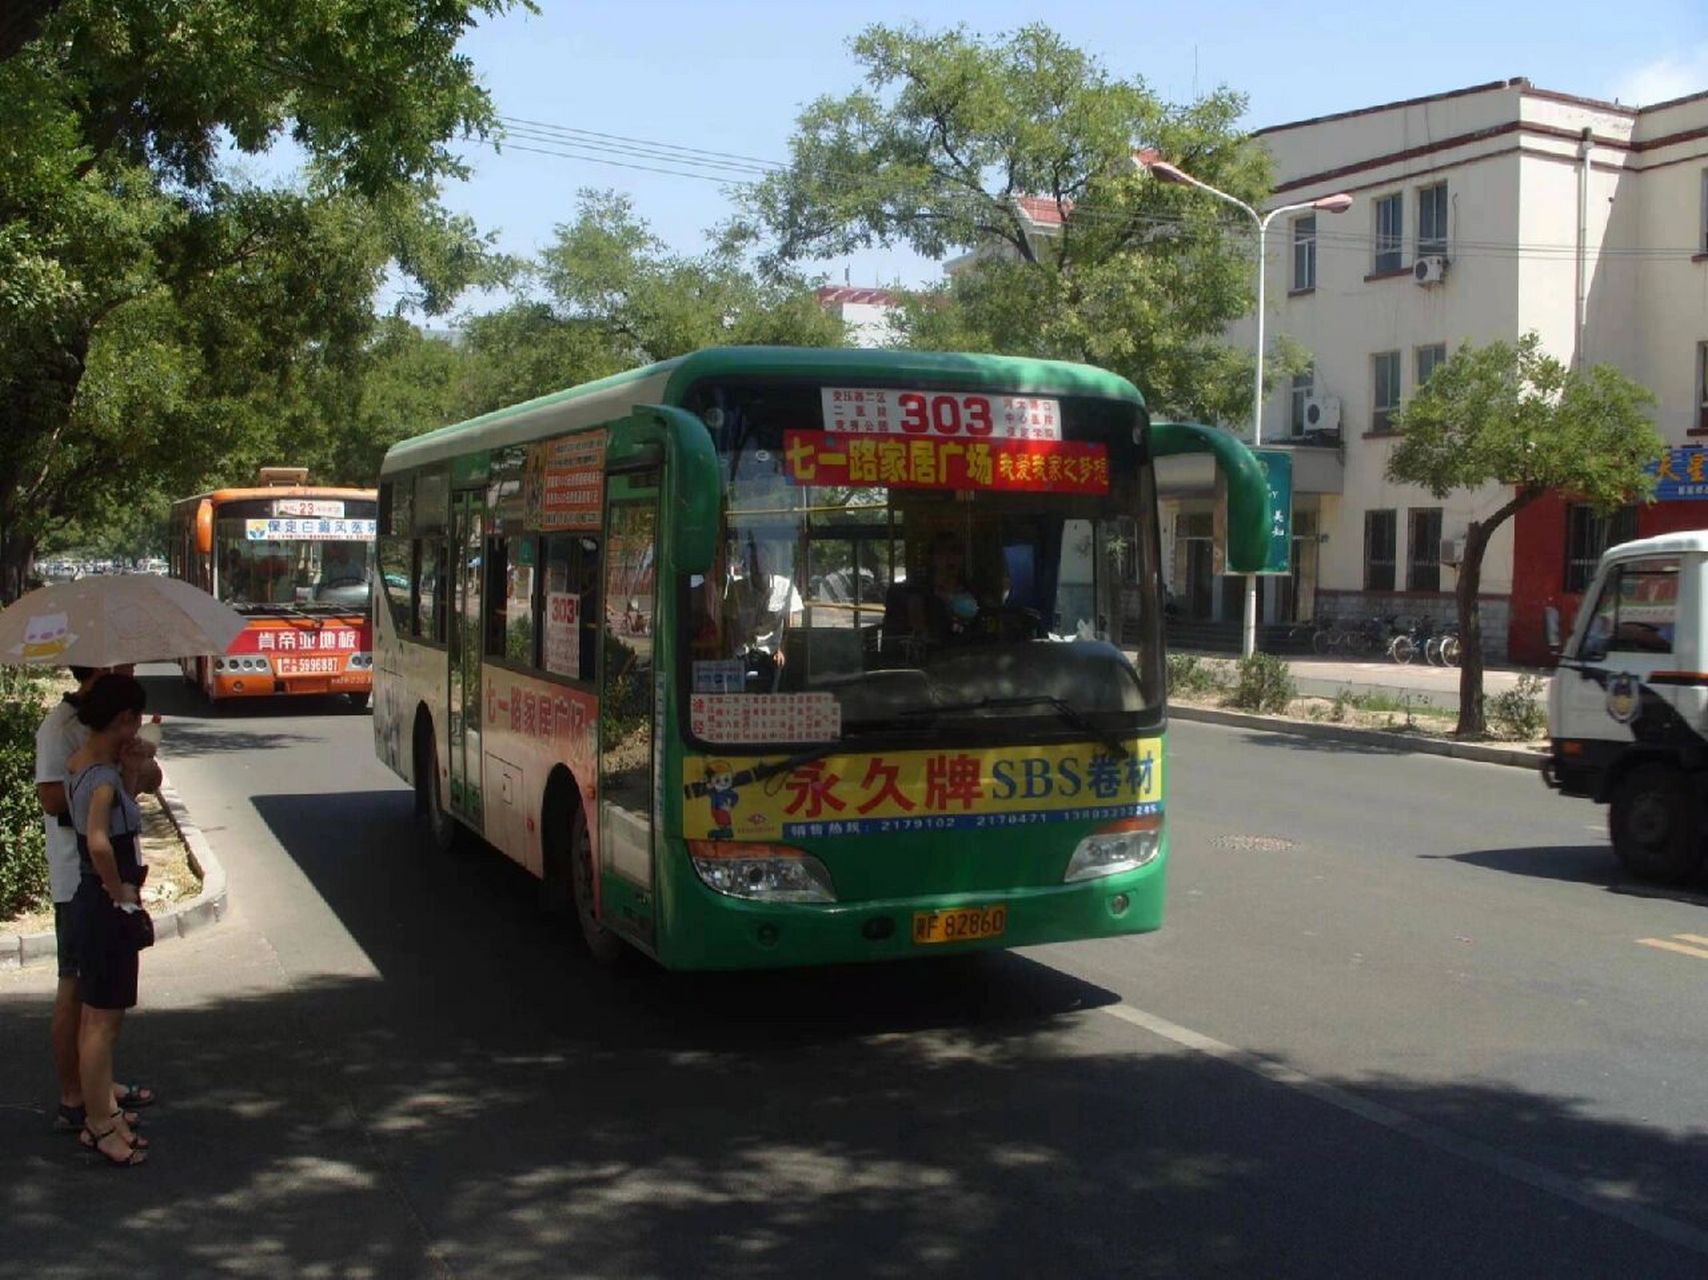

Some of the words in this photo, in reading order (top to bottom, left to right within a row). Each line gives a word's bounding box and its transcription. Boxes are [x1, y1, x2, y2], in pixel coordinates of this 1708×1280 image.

[898, 392, 993, 436] 303
[785, 437, 993, 486] 七一路家居广场
[299, 502, 315, 515] 23
